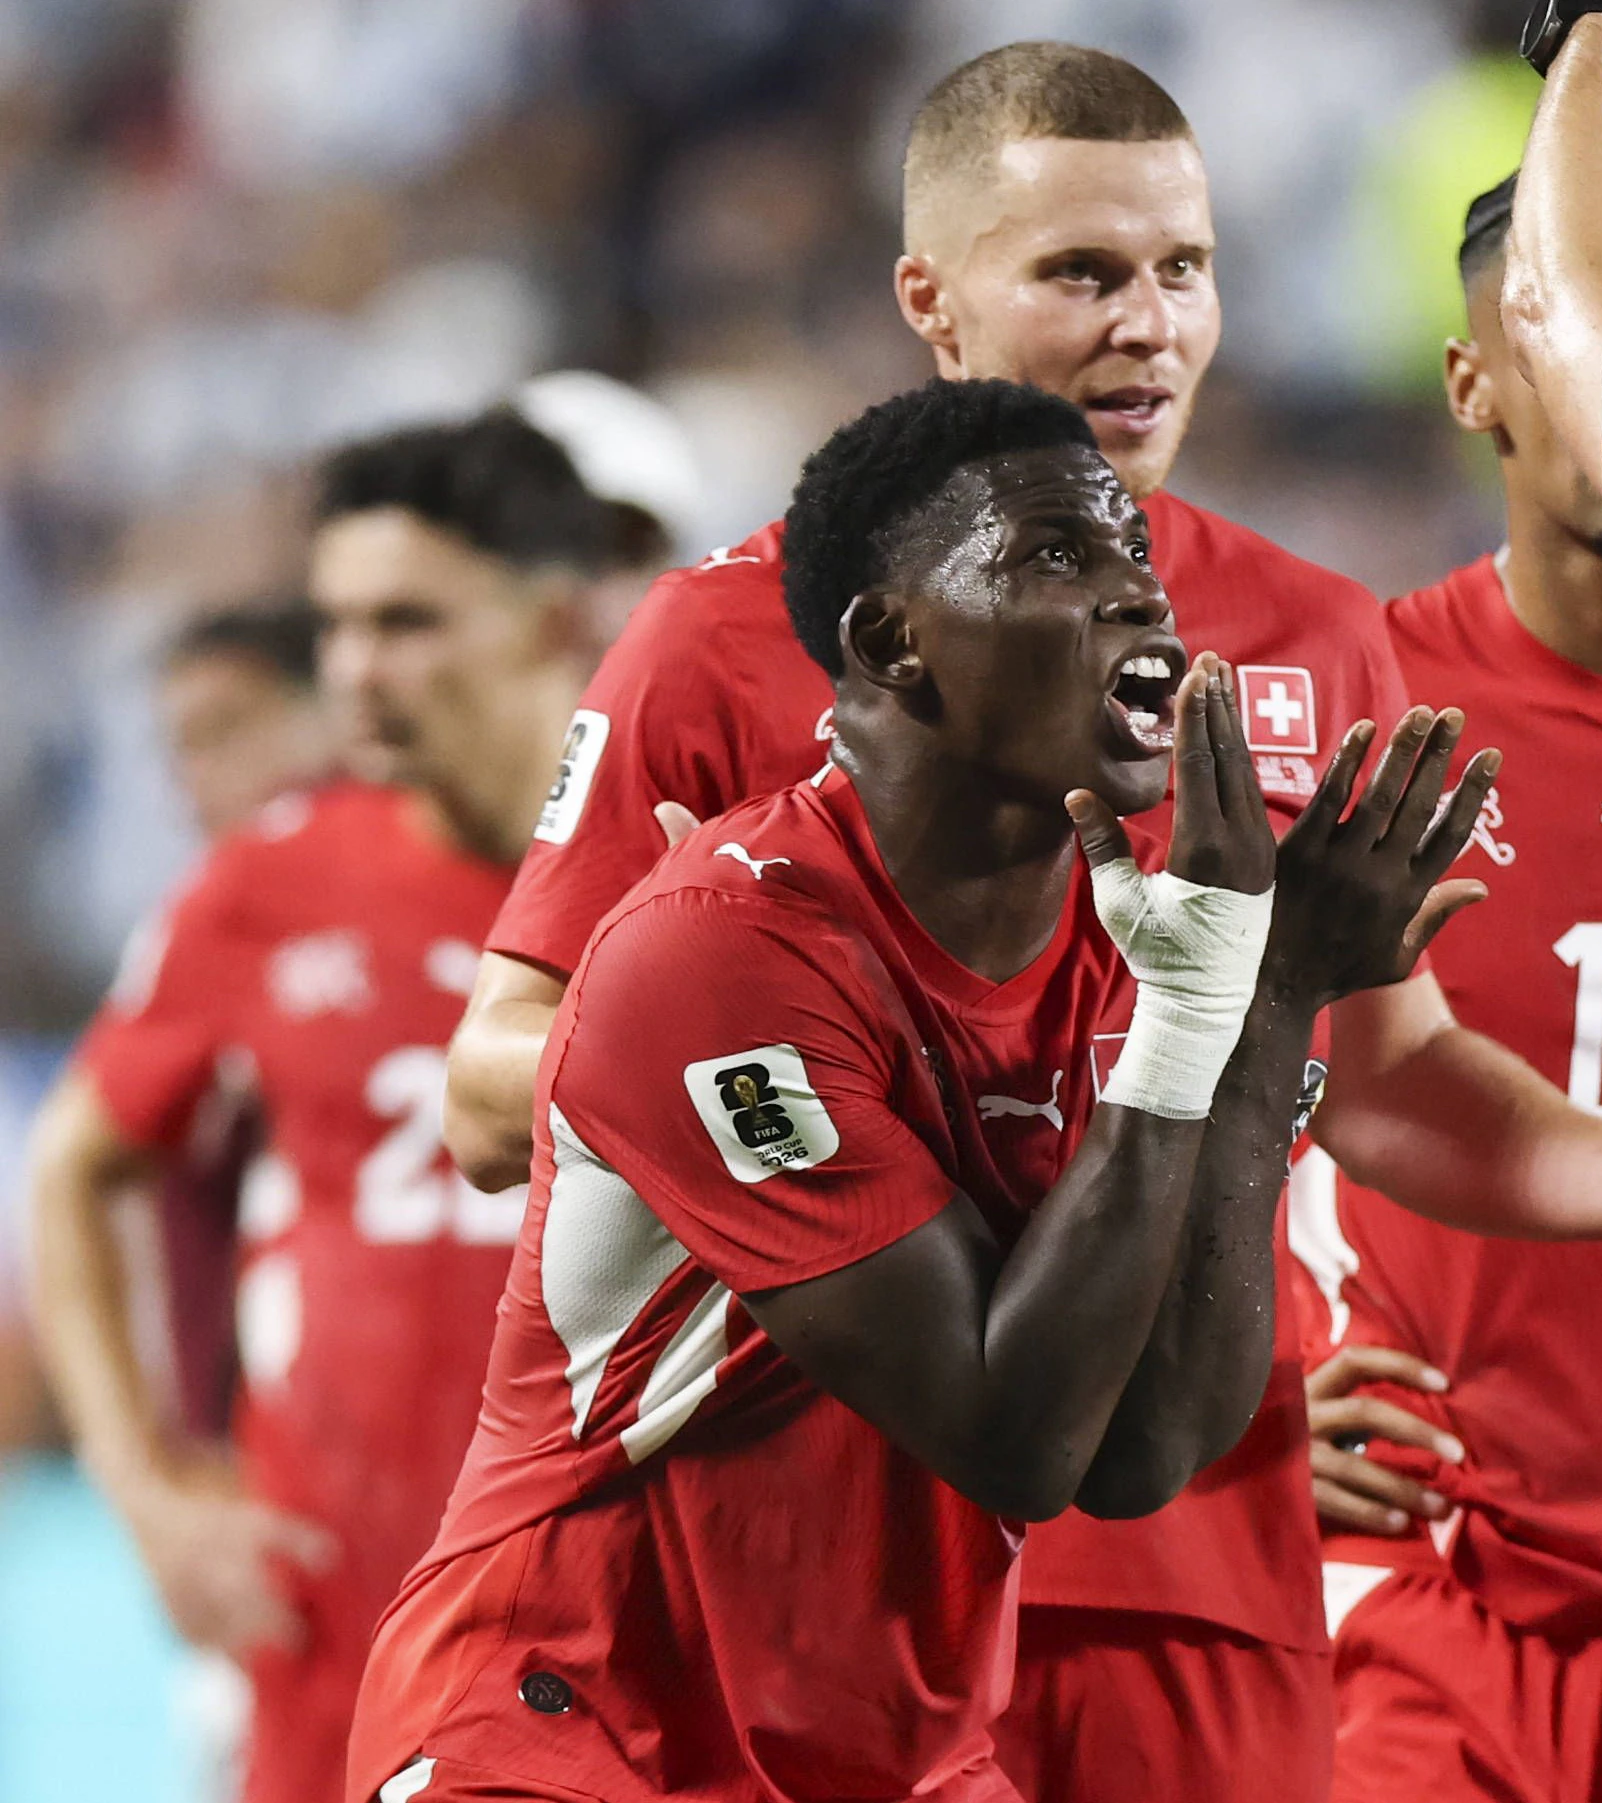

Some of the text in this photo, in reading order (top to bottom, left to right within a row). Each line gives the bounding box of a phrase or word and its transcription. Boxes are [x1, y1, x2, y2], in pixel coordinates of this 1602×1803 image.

[356, 1044, 530, 1244] 2
[753, 1125, 781, 1141] FIFA
[756, 1138, 803, 1162] ORLD CUP
